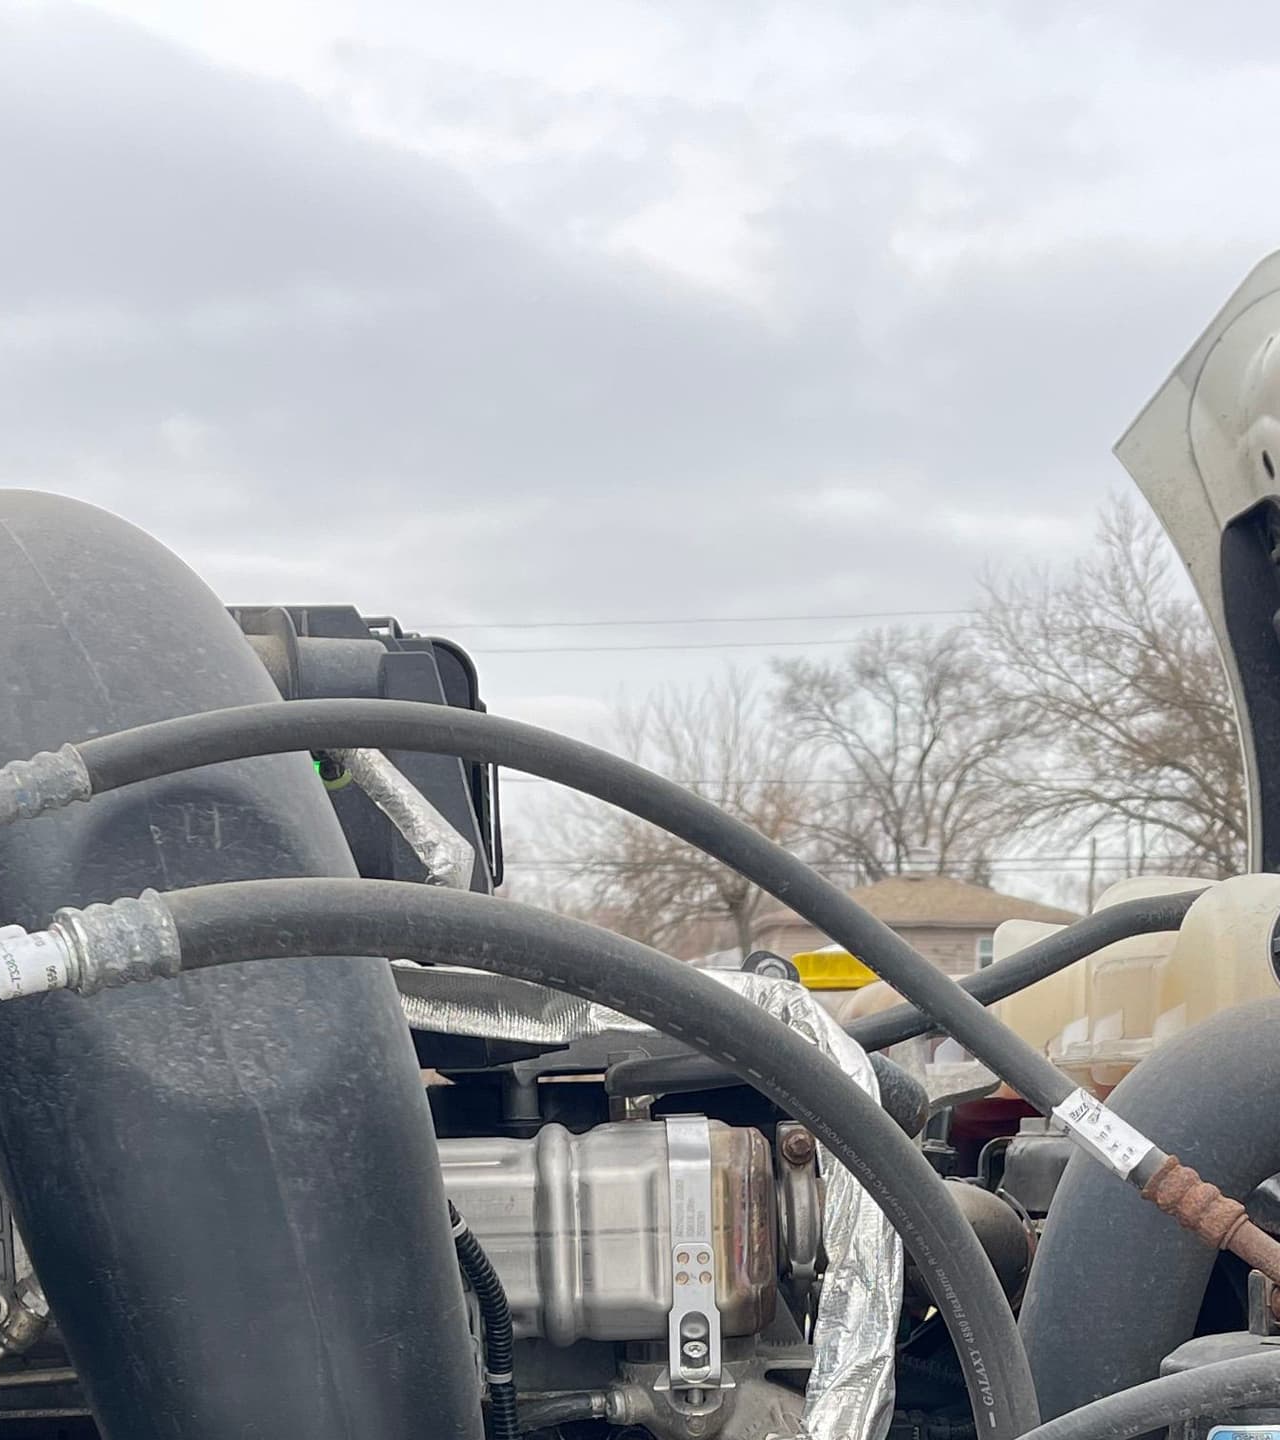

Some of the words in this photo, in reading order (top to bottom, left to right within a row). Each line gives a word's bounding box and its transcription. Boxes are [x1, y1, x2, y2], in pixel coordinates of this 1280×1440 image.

[821, 1122, 844, 1147] HOSE
[842, 1144, 874, 1181] SUCTION
[968, 1347, 994, 1407] GALAXY
